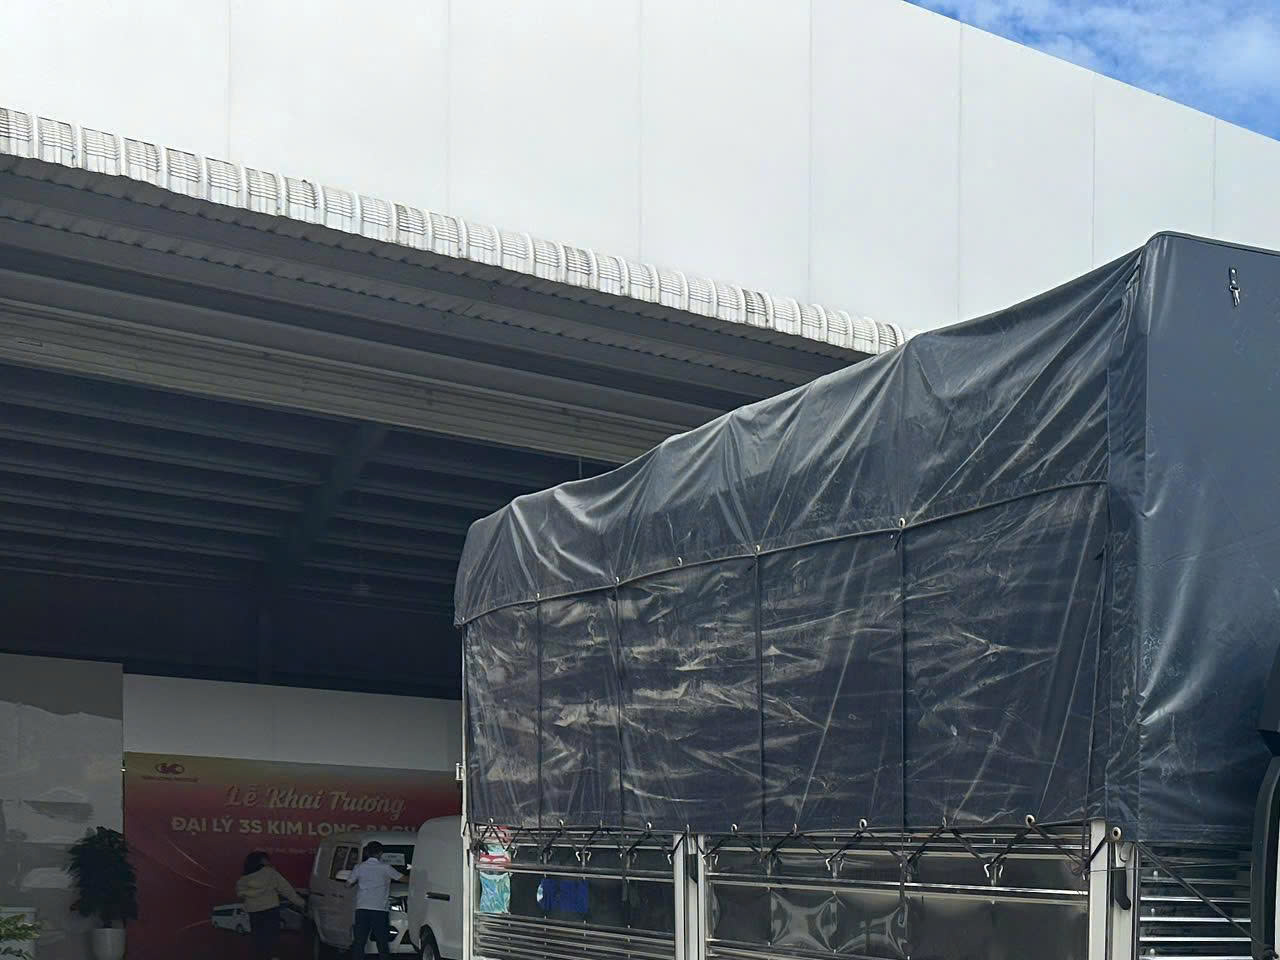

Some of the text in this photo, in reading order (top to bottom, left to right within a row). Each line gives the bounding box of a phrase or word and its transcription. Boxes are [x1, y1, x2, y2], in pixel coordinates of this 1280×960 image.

[265, 787, 324, 810] Khai
[171, 817, 206, 836] ĐẠI
[212, 814, 235, 833] LÝ
[239, 820, 262, 834] 3S
[267, 820, 304, 835] KIM
